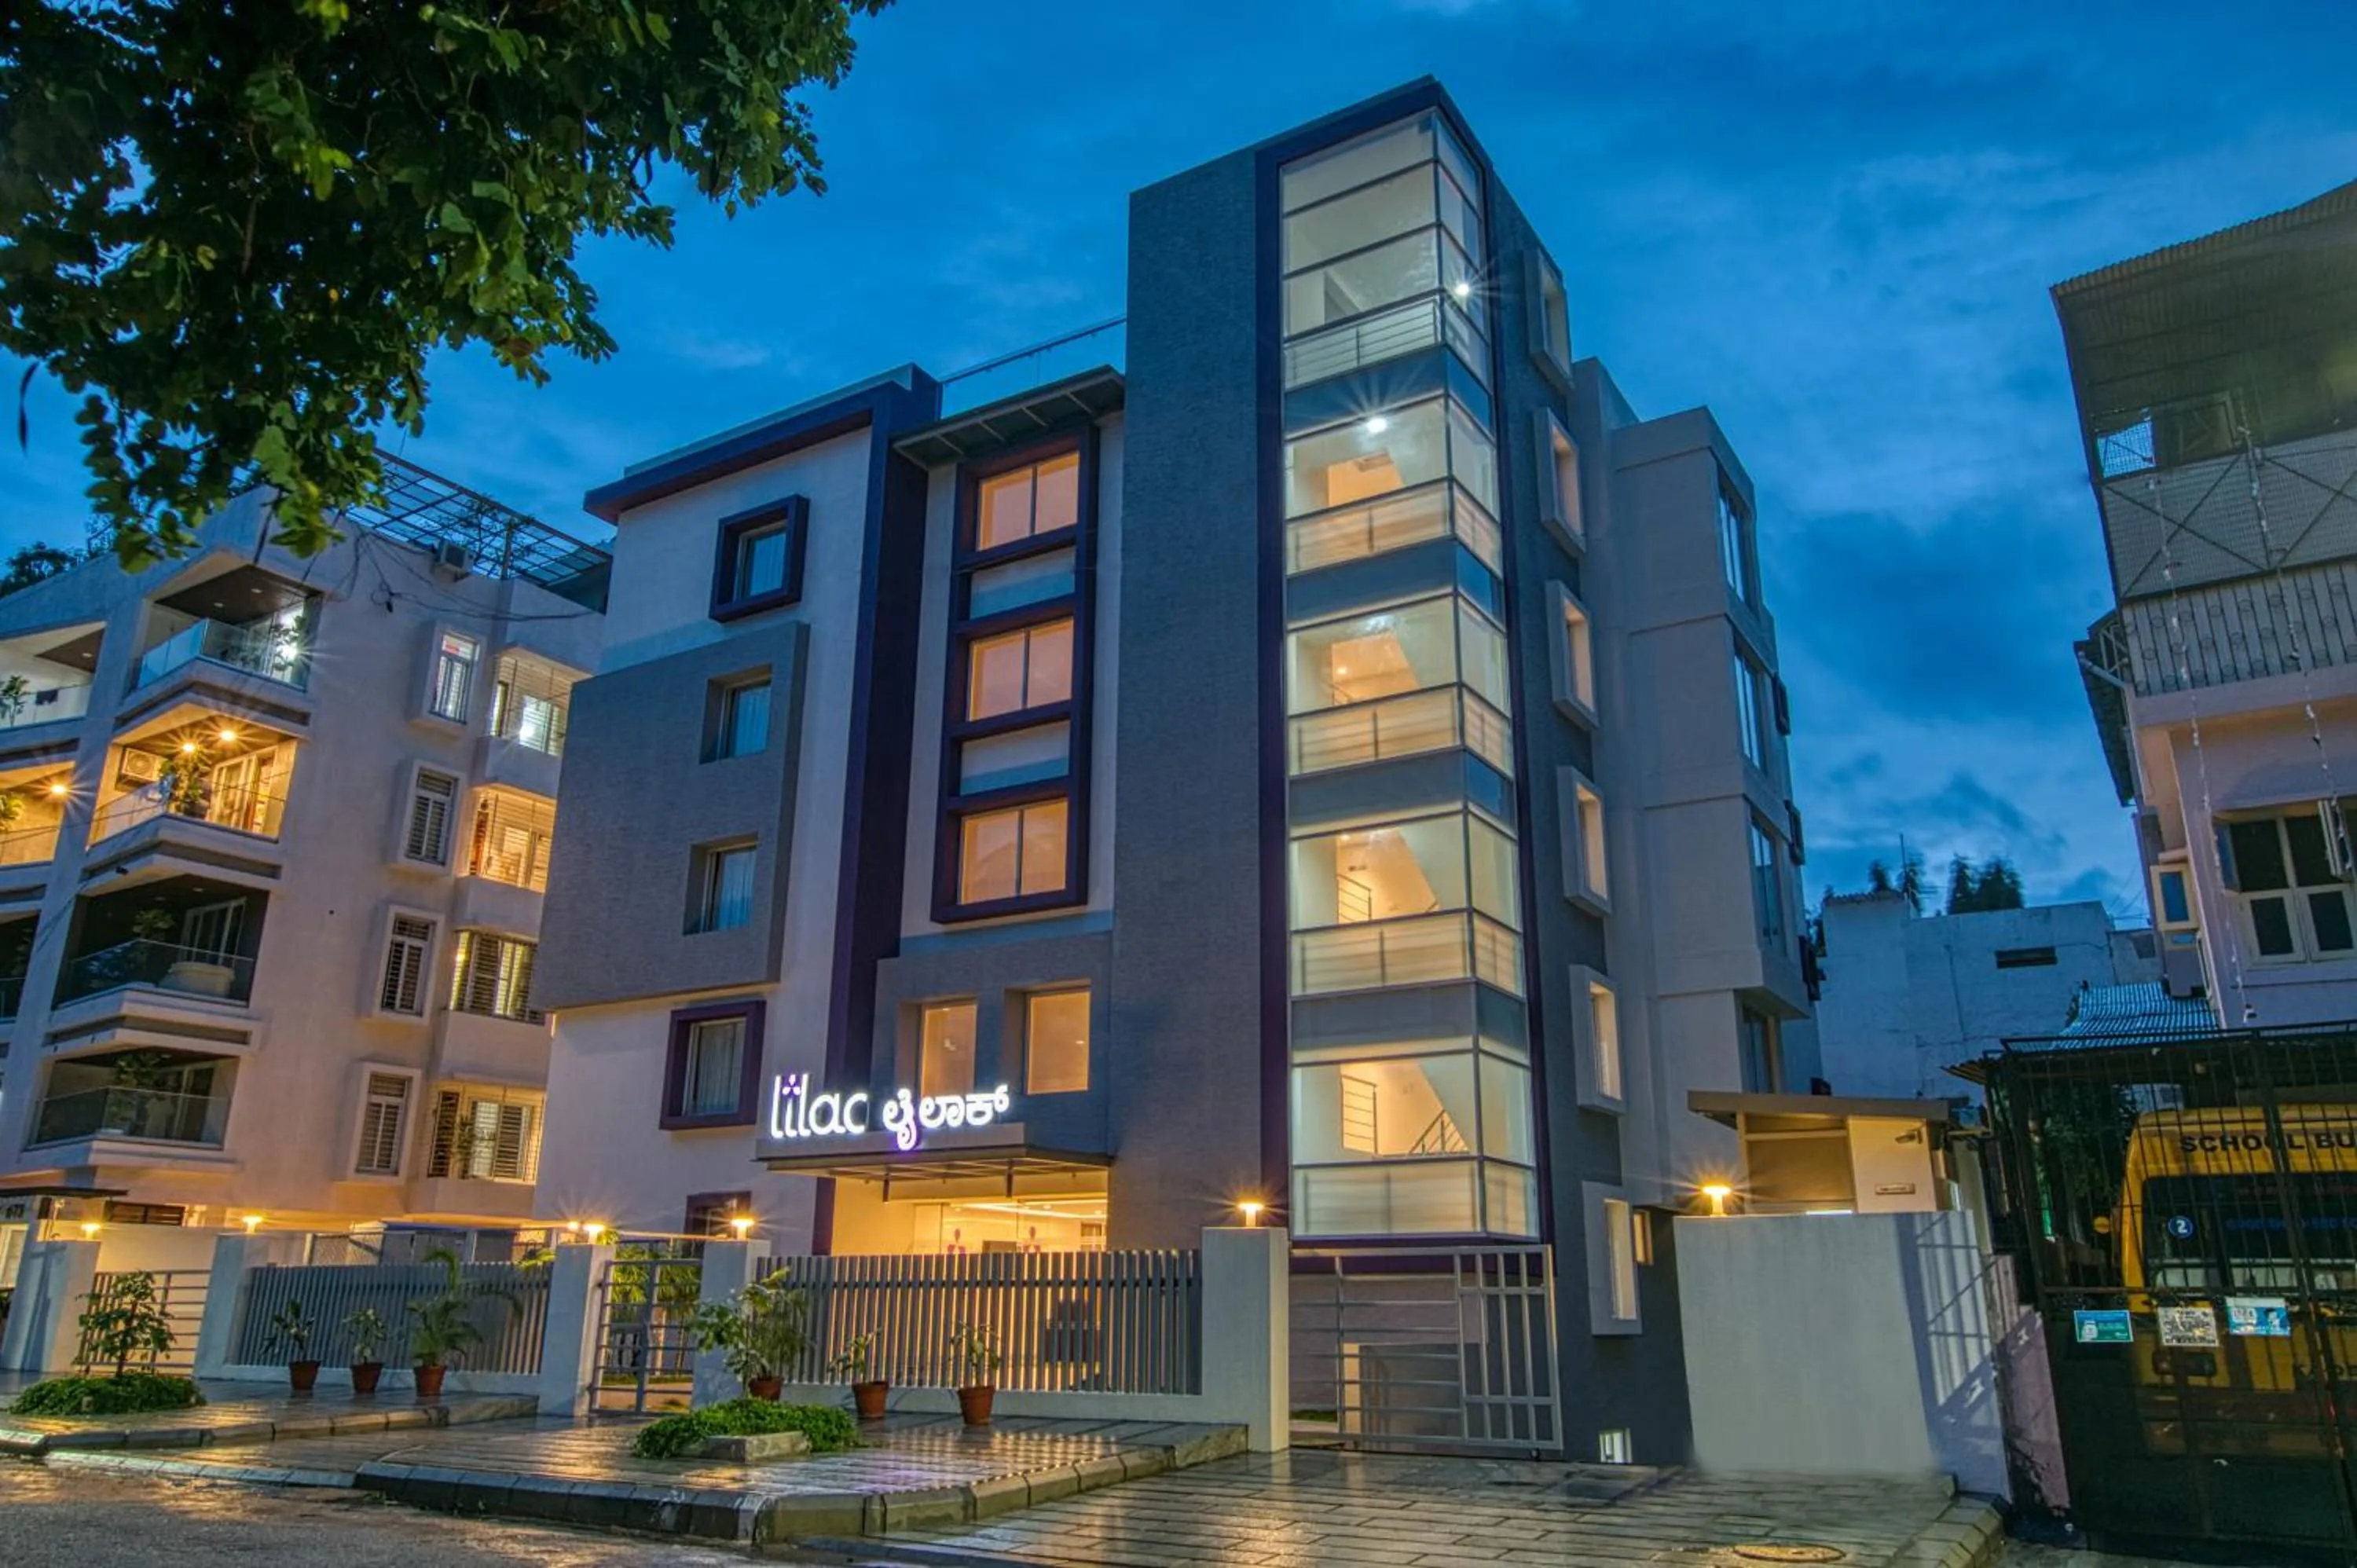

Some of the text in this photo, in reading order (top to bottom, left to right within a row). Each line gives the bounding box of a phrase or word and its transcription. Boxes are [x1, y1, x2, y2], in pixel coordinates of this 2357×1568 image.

[771, 1074, 867, 1138] lilac
[882, 1086, 1010, 1151] ಲೈಲಾಕ್
[2177, 1220, 2189, 1234] 2
